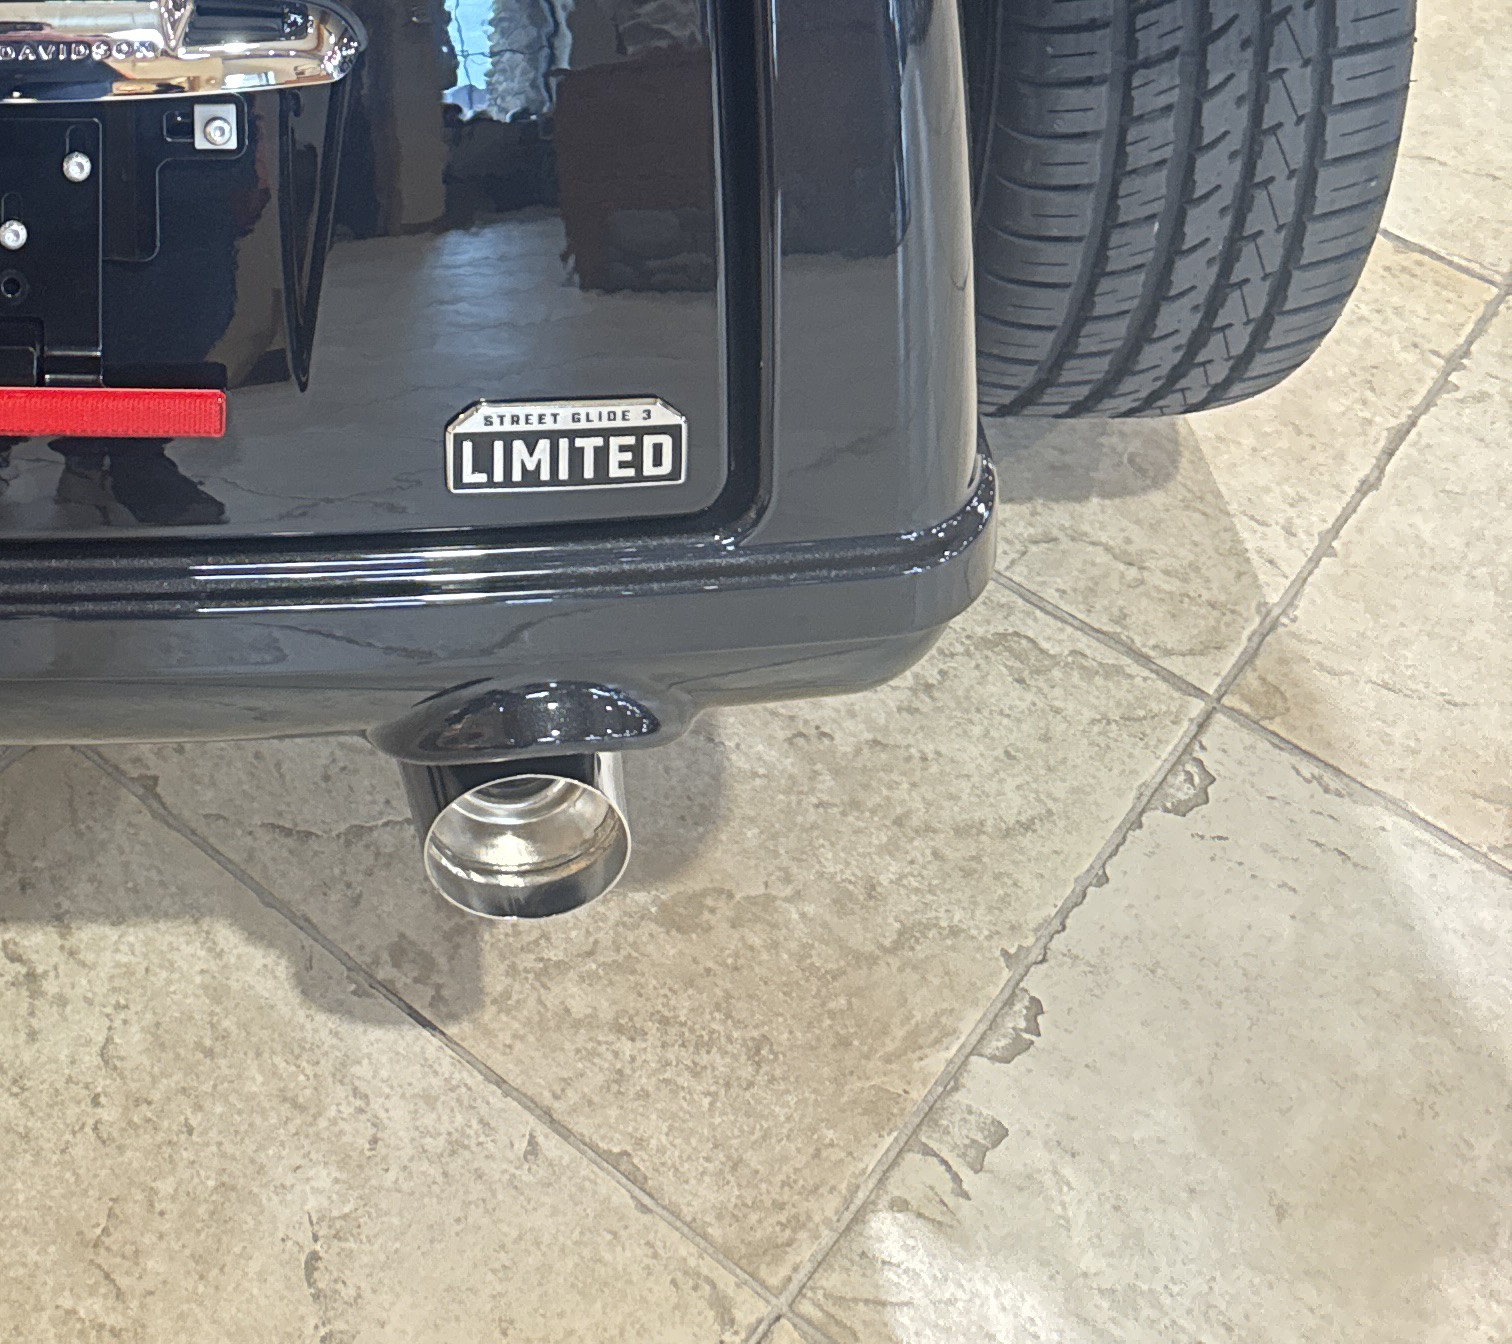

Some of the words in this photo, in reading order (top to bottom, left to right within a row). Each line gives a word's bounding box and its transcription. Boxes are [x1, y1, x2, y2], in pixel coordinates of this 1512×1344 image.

[483, 412, 561, 427] STREET
[571, 409, 631, 424] GLIDE
[641, 408, 653, 421] 3
[461, 433, 674, 483] LIMITED
